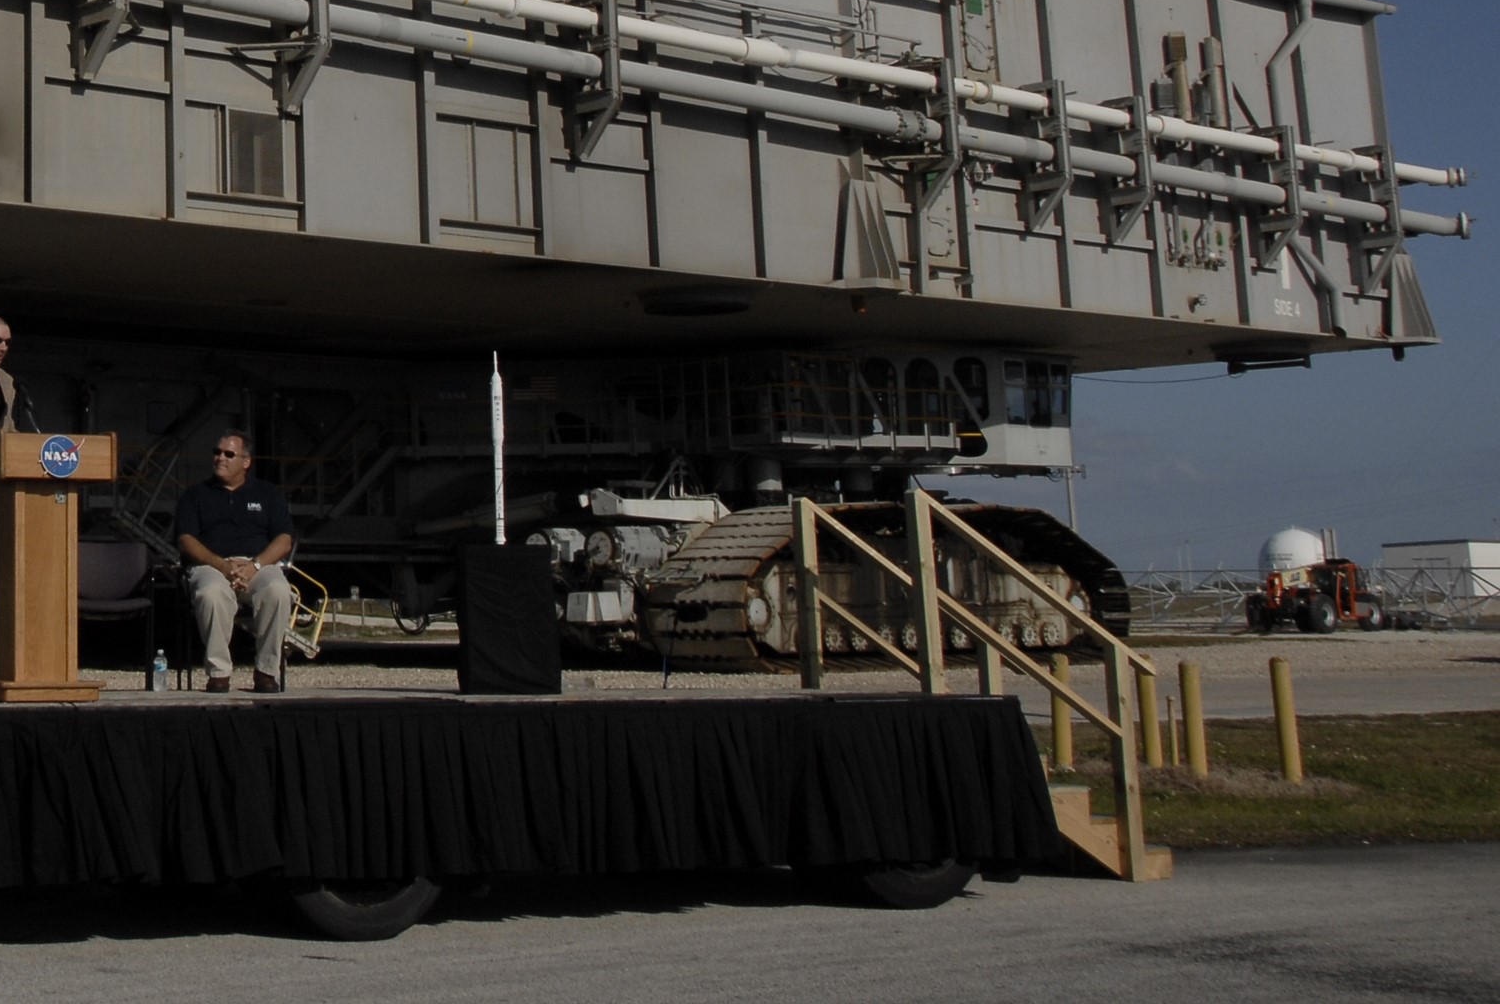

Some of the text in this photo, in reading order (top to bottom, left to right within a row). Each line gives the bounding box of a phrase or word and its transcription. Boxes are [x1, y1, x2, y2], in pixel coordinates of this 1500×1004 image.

[1274, 298, 1301, 317] SIDE 4
[44, 451, 78, 462] NASA
